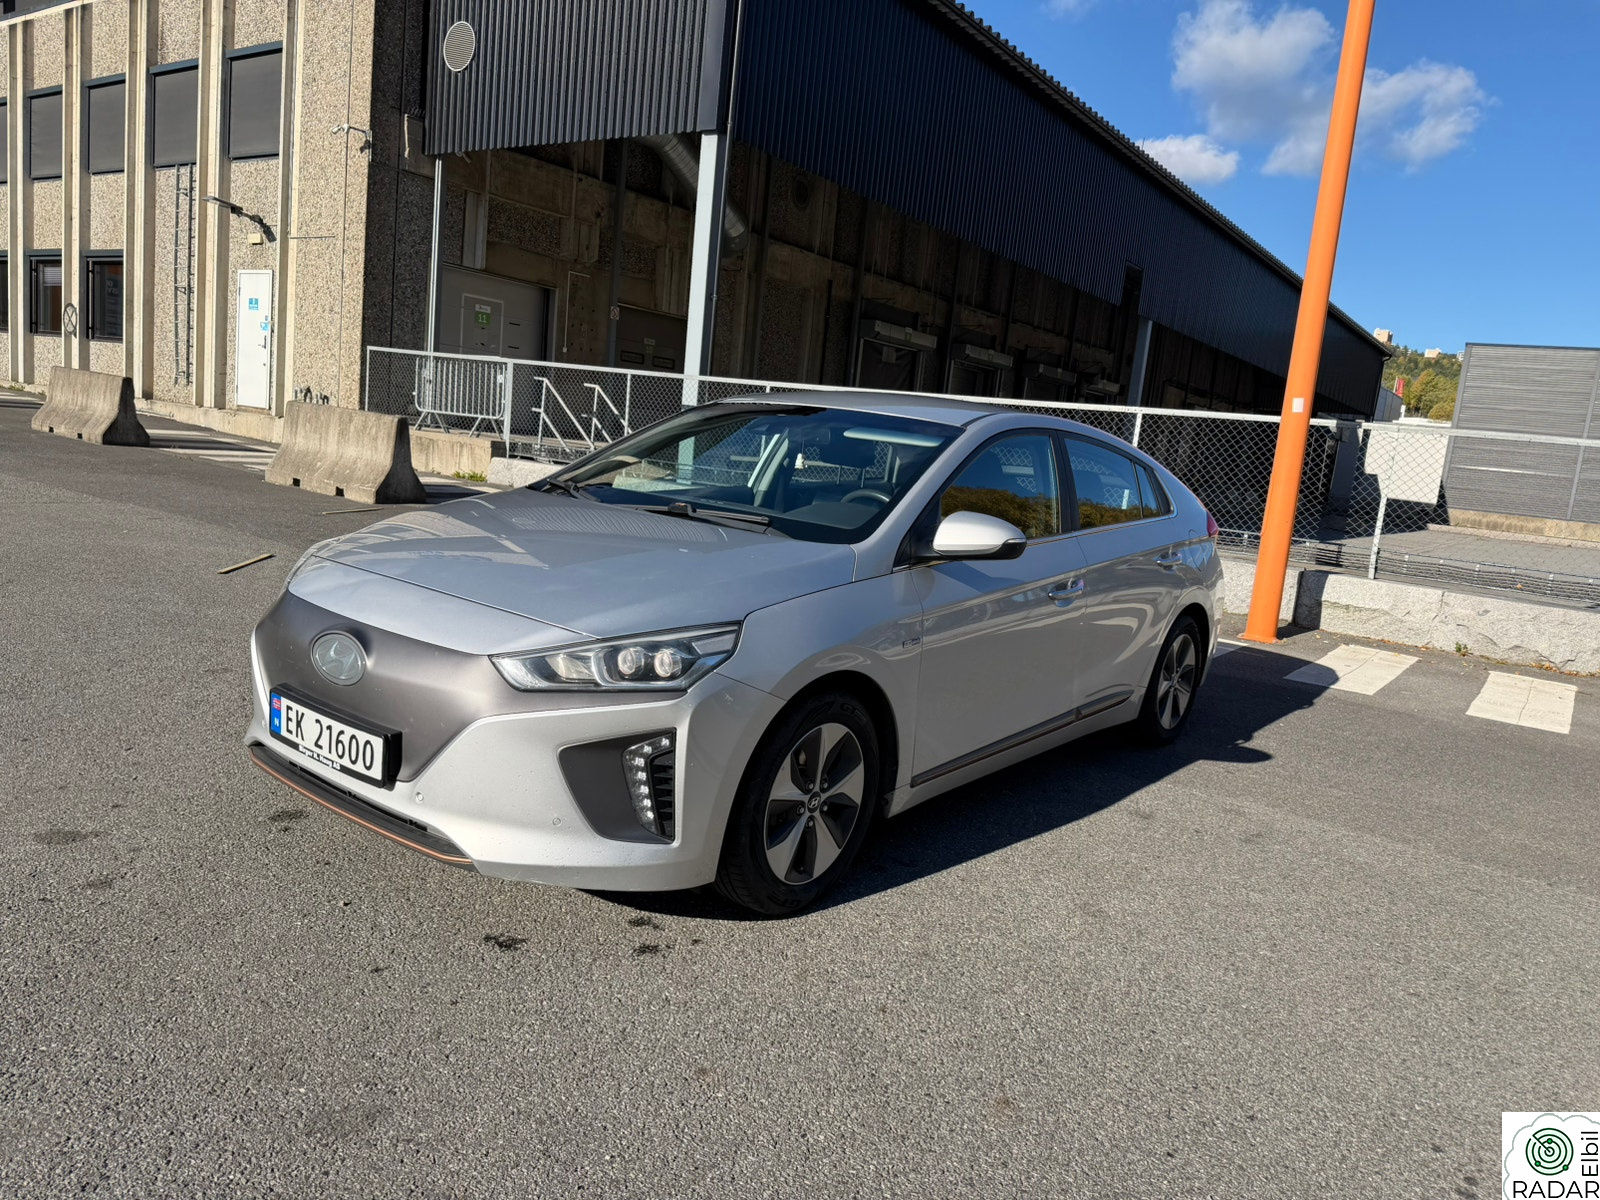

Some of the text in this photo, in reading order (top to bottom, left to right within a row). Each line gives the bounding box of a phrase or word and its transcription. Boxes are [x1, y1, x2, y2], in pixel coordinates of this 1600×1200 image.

[478, 313, 487, 323] 11
[286, 704, 375, 772] EK 21600
